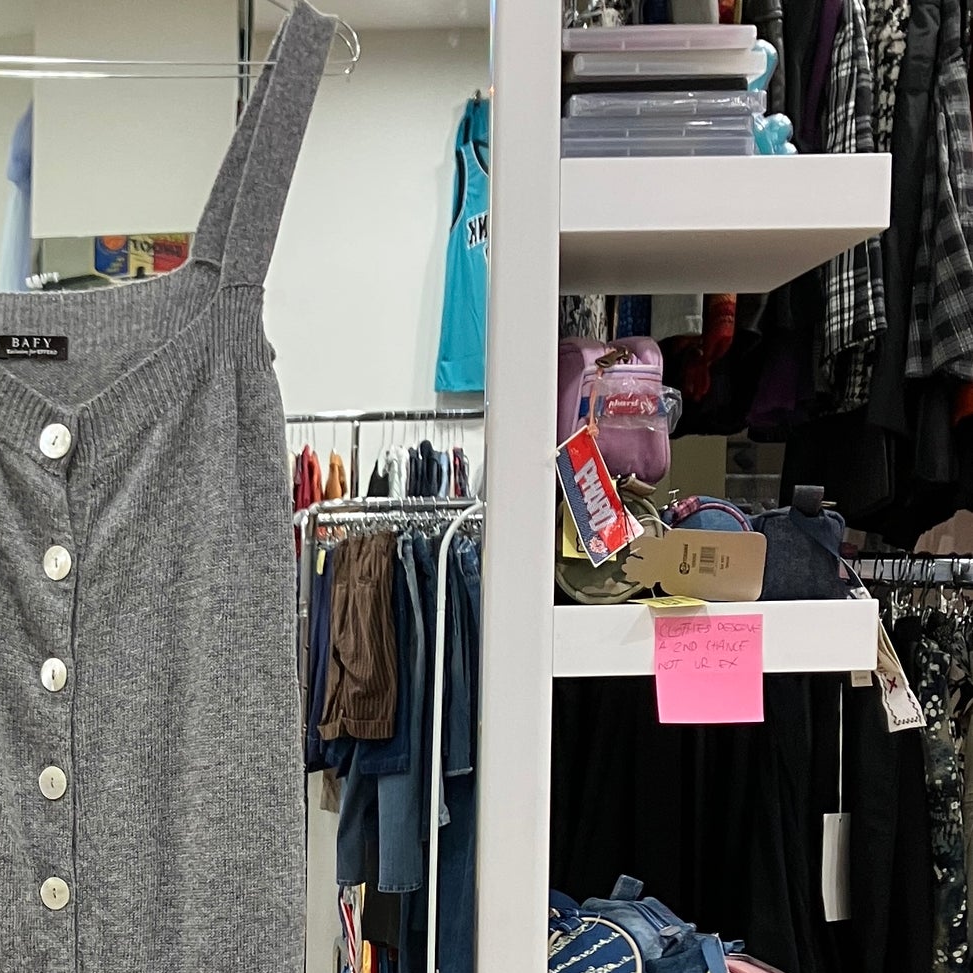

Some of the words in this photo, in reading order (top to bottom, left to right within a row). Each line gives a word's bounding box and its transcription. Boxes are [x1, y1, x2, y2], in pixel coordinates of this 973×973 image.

[11, 337, 52, 348] BAFY
[574, 457, 618, 533] PHARD
[658, 641, 667, 650] A
[673, 641, 698, 653] 2ND
[706, 639, 750, 652] CHANCE
[658, 659, 683, 670] NOT
[694, 657, 712, 670] UR
[718, 656, 739, 669] EX
